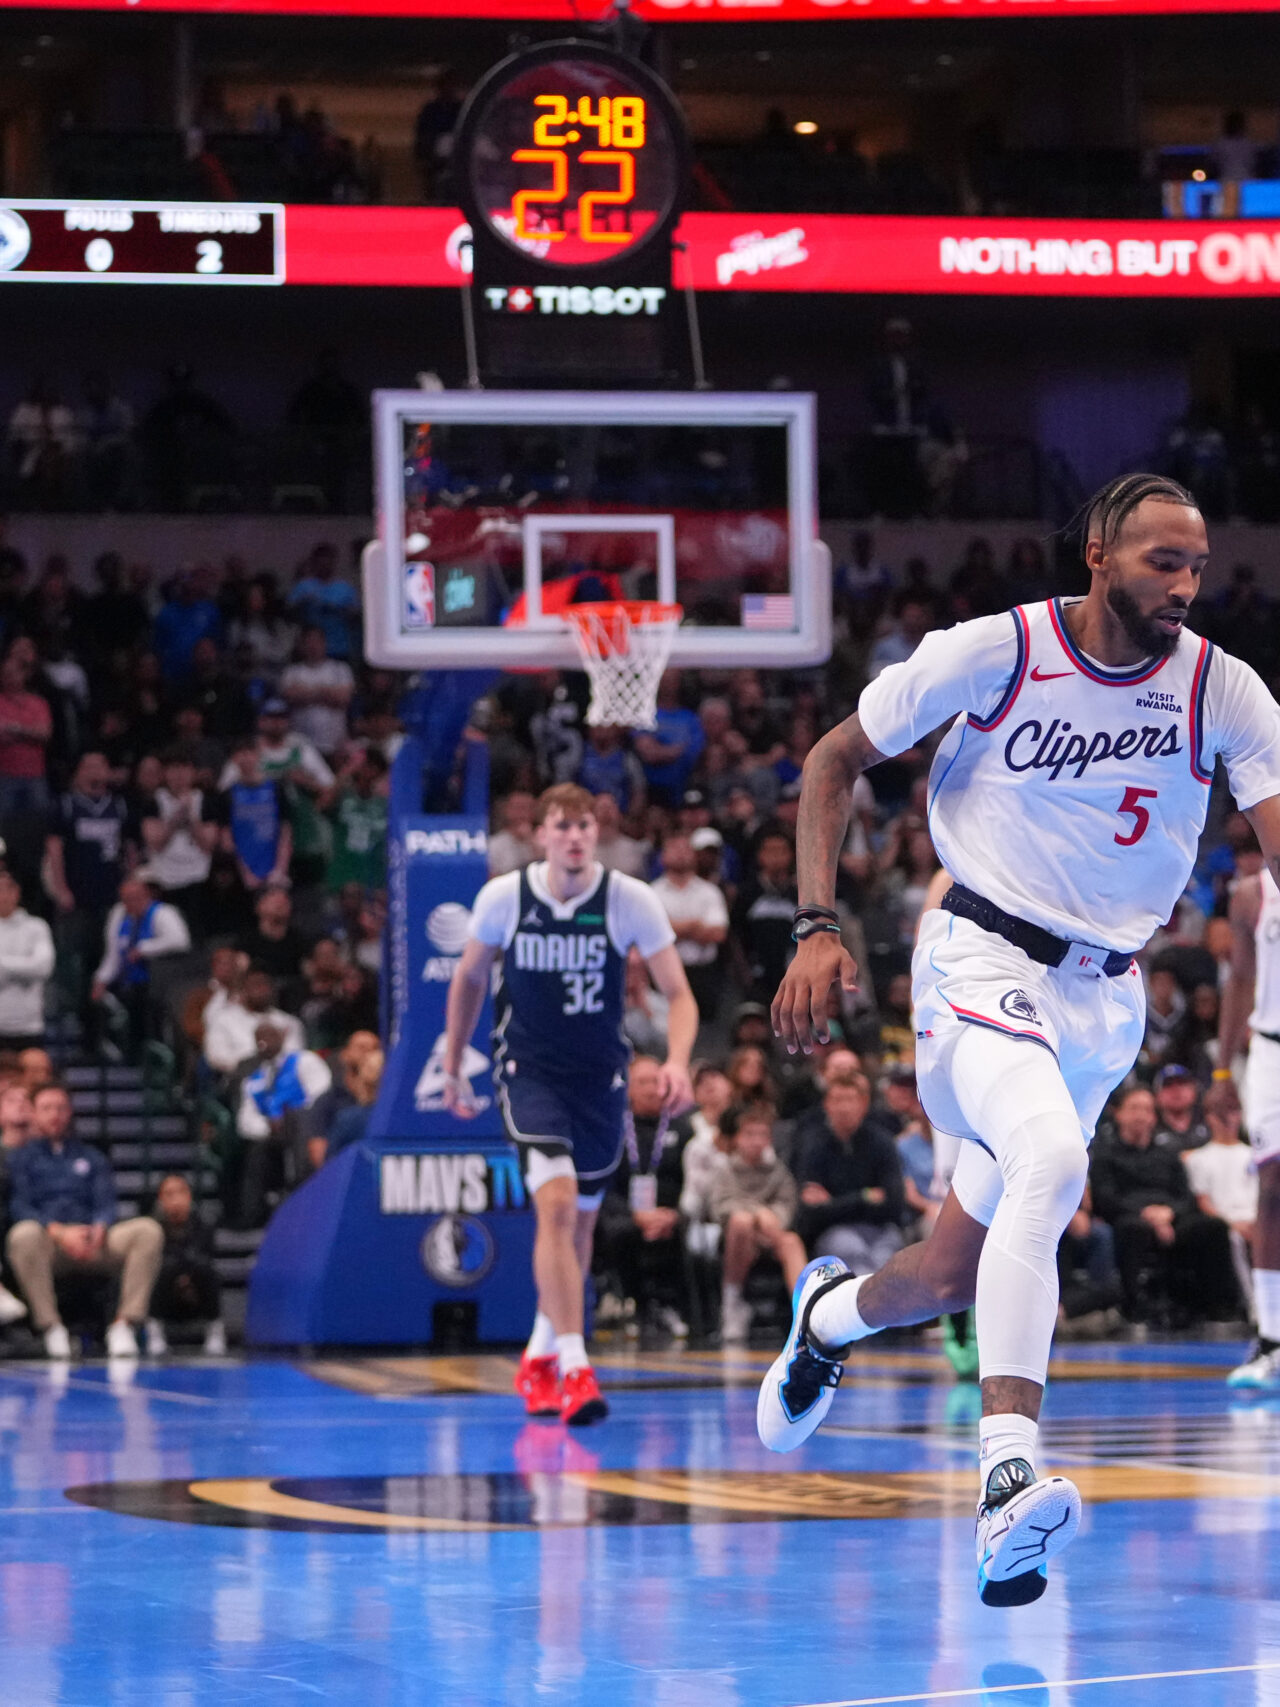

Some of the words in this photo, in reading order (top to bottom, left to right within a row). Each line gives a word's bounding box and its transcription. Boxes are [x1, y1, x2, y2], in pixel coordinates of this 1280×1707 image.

[533, 95, 646, 148] 2:48
[511, 149, 636, 243] 22
[195, 239, 224, 274] 2
[939, 236, 1112, 277] NOTHING
[1116, 239, 1200, 277] BUT
[533, 285, 667, 315] TISSOT
[1136, 698, 1183, 714] RWANDA
[1147, 690, 1175, 703] VISIT
[1003, 718, 1184, 782] Clippers
[1113, 786, 1158, 847] 5
[514, 931, 608, 973] MAVS
[561, 971, 605, 1016] 32
